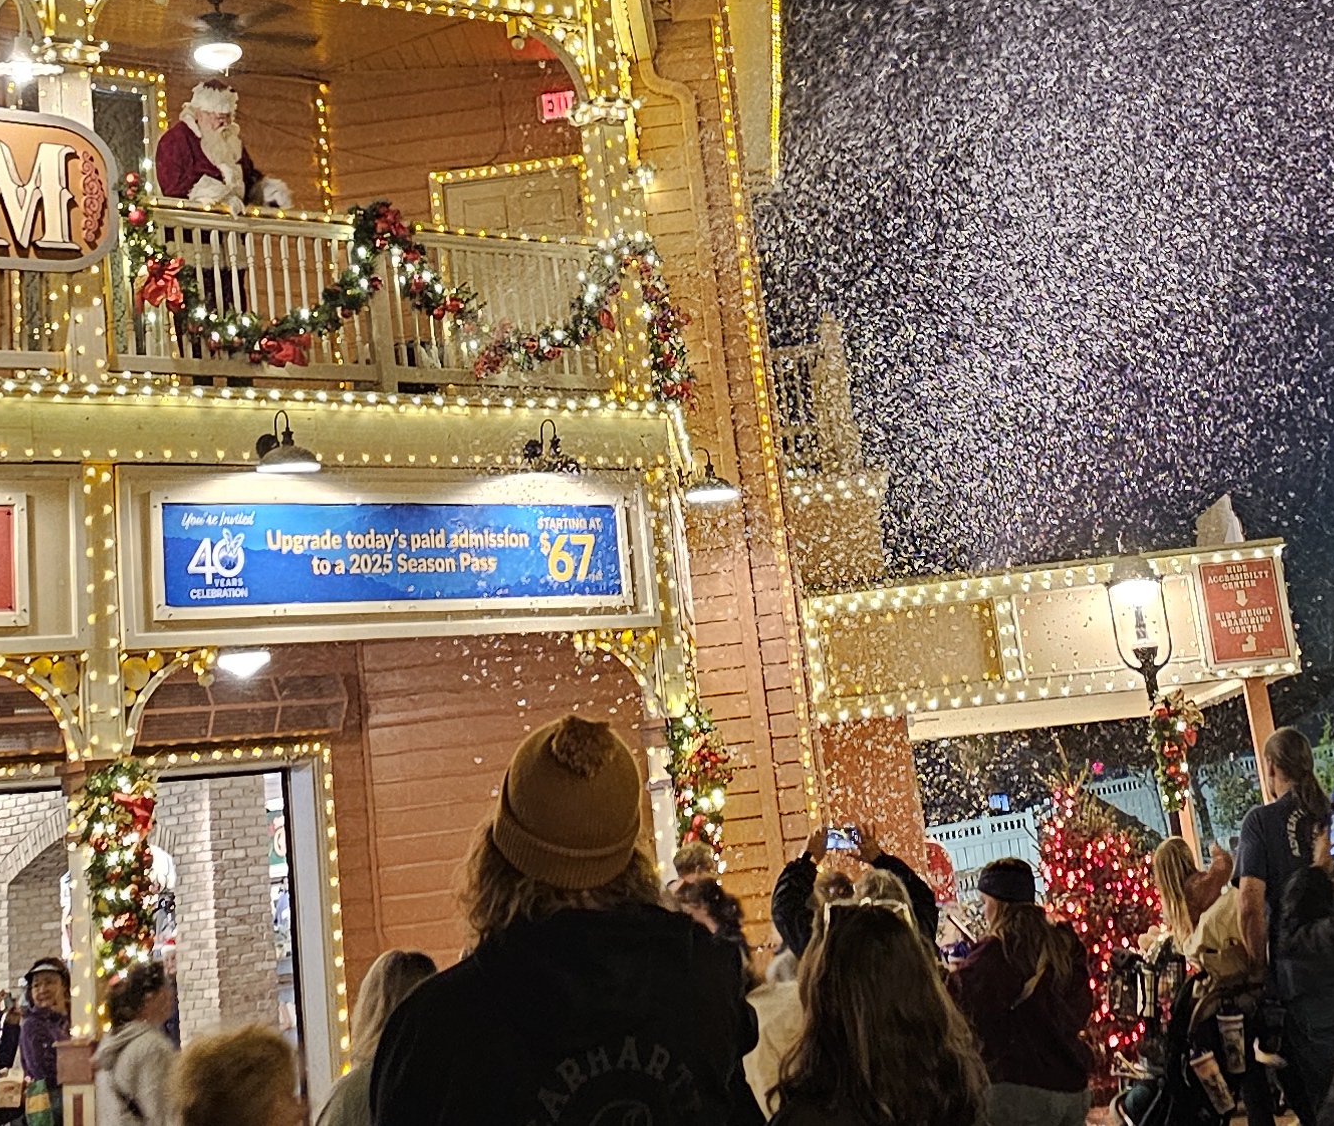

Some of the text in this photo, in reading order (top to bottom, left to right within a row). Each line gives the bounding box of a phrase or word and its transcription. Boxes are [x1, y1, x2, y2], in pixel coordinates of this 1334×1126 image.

[537, 516, 603, 531] STARTING AT
[266, 526, 530, 554] Upgrade today's paid admission
[186, 536, 246, 585] 40
[311, 552, 497, 575] to a 2025 Season Pass
[539, 531, 595, 583] $67
[1226, 564, 1248, 574] RIDE
[214, 577, 244, 588] YEARS
[1221, 580, 1257, 591] CENTER
[189, 586, 249, 600] CELEBRATION
